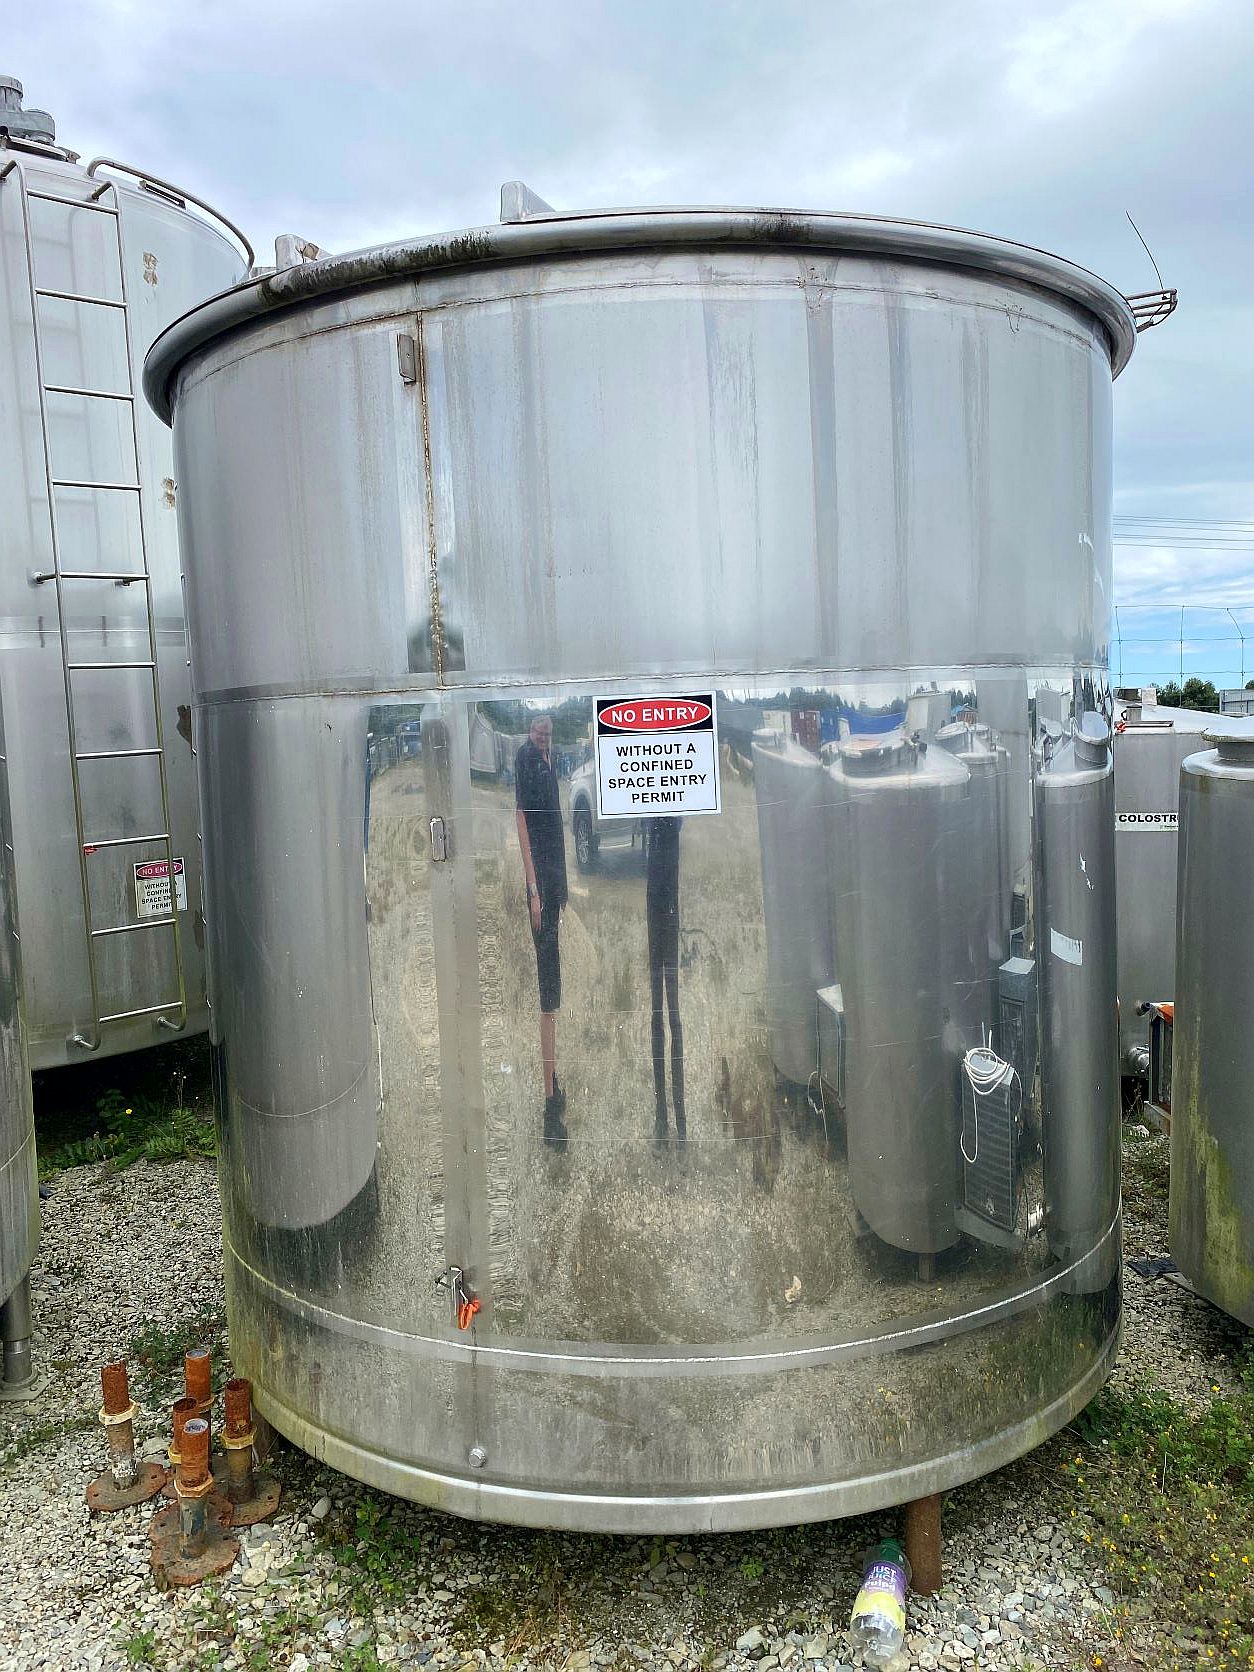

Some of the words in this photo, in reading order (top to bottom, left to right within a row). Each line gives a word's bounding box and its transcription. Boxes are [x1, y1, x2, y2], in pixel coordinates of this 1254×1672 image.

[611, 710, 636, 723] NO
[642, 706, 699, 722] ENTRY
[616, 743, 682, 757] WITHOUT
[686, 742, 696, 754] A
[620, 759, 694, 773] CONFINED
[608, 776, 655, 789] SPACE
[660, 774, 707, 787] ENTRY
[632, 791, 685, 804] PERMIT
[1118, 814, 1178, 823] COLOSTR
[155, 865, 178, 874] ENTY
[145, 882, 170, 890] WITHOU
[141, 896, 162, 905] SPACE
[873, 1565, 897, 1578] JUST
